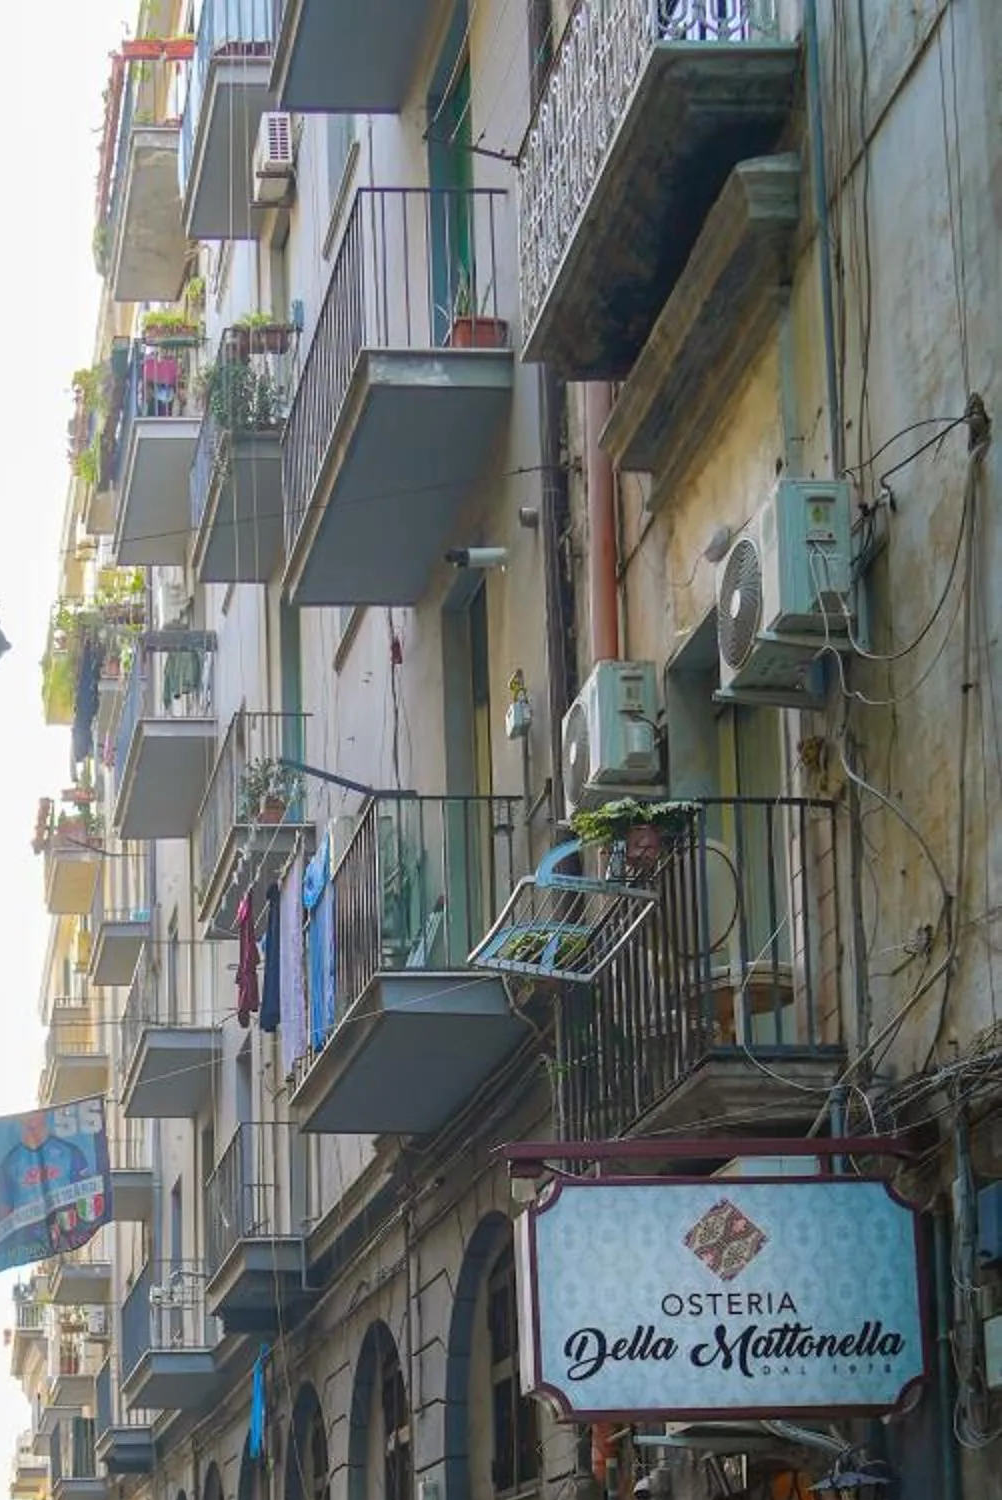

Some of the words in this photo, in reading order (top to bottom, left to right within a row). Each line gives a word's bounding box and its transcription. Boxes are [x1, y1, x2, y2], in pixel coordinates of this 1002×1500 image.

[661, 1292, 798, 1317] OSTERIA
[564, 1324, 678, 1381] Della
[689, 1320, 905, 1378] Mattonella
[762, 1364, 806, 1376] DAL
[832, 1362, 892, 1375] 1978
